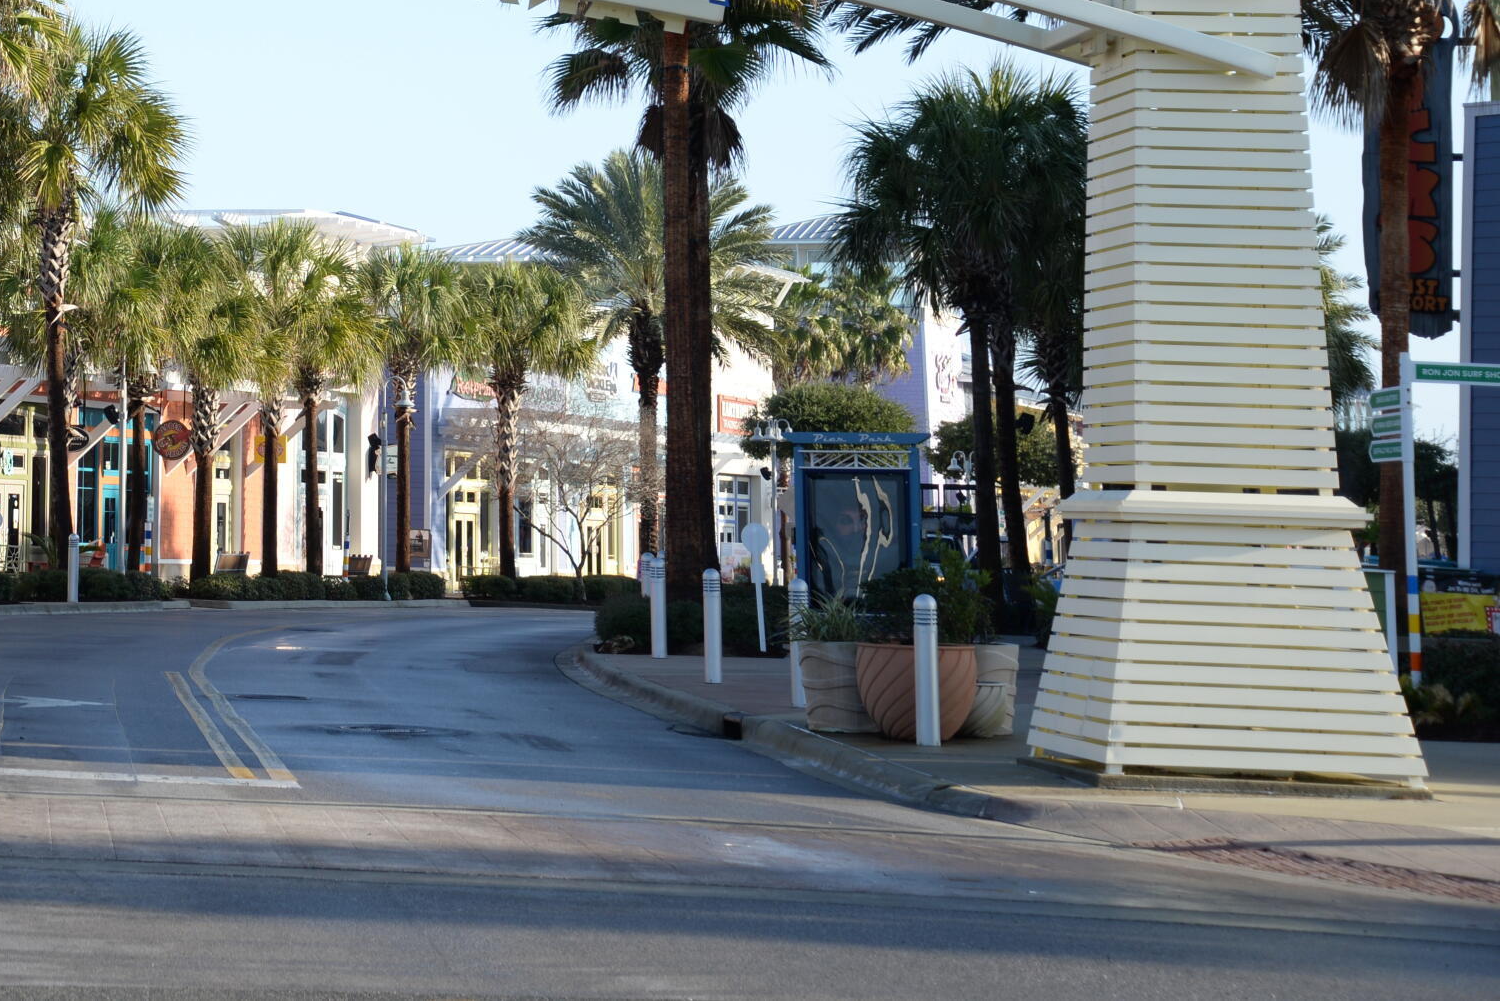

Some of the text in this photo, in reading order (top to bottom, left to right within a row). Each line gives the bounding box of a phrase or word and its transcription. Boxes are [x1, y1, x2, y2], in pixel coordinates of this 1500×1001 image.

[1421, 368, 1441, 376] RON
[1442, 369, 1460, 377] JON
[1461, 370, 1483, 378] SURF
[812, 433, 895, 442] Pier Park
